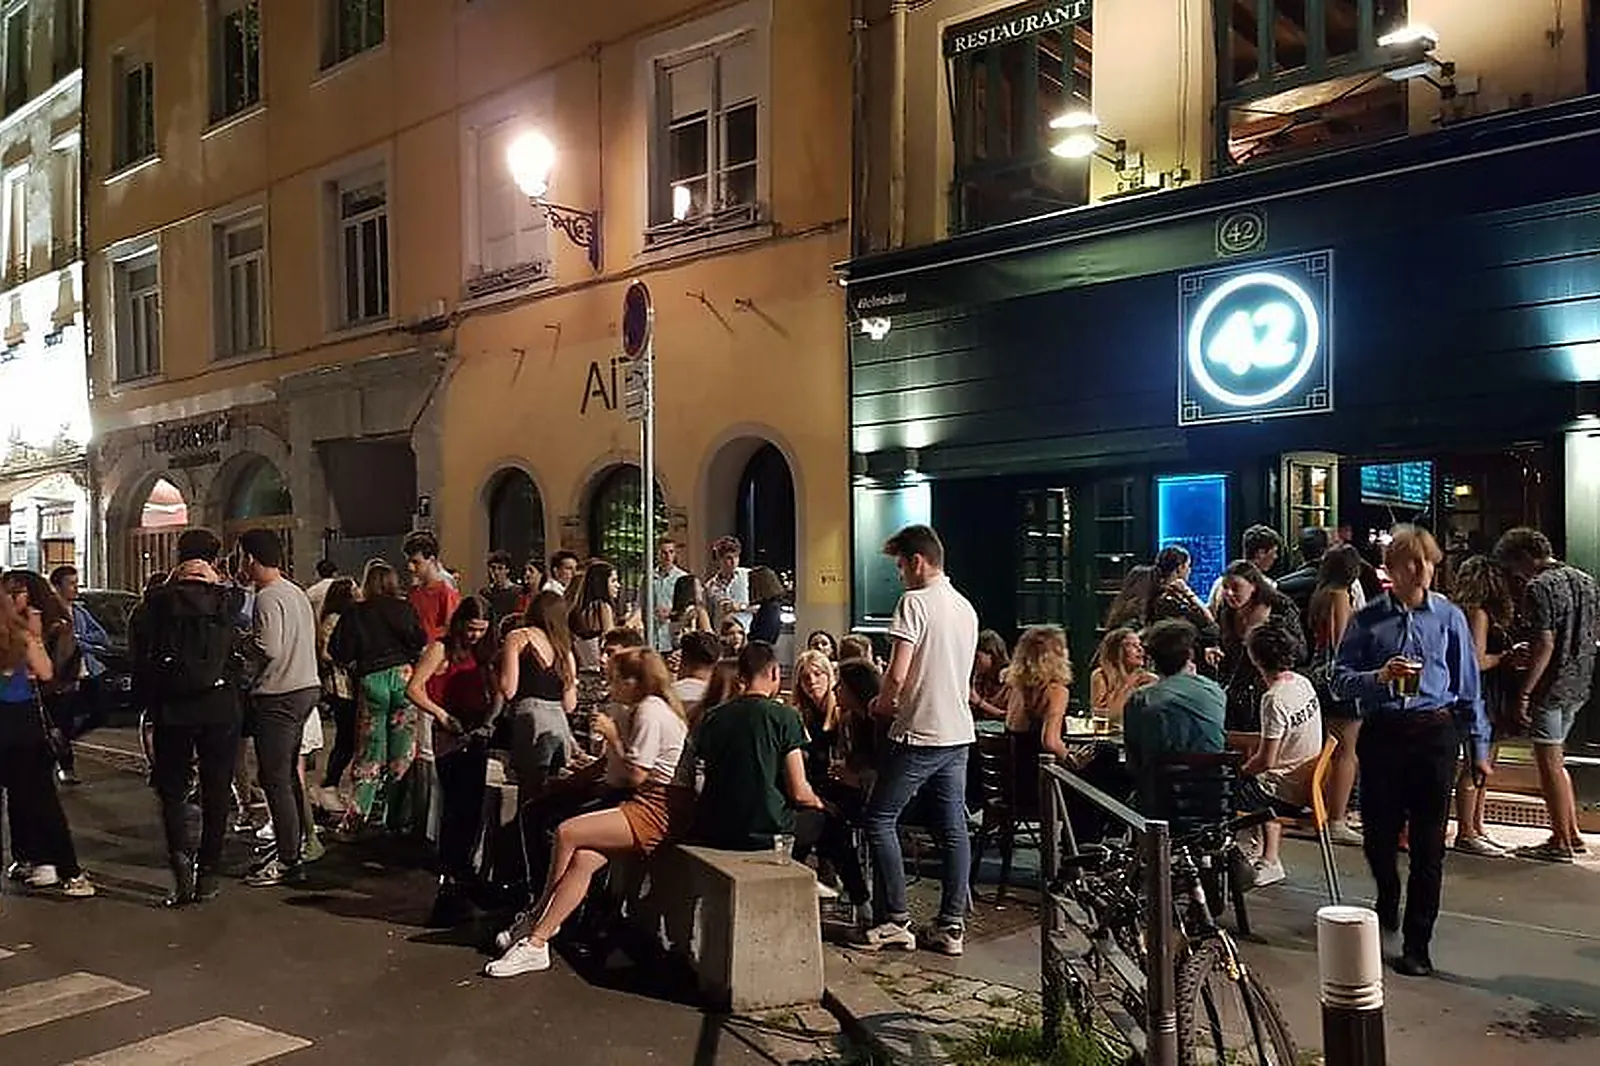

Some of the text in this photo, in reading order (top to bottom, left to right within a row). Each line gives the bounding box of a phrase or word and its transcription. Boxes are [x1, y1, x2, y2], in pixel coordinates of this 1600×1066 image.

[954, 0, 1086, 52] RESTAURANT
[1226, 220, 1255, 242] 42
[1207, 302, 1296, 375] 42
